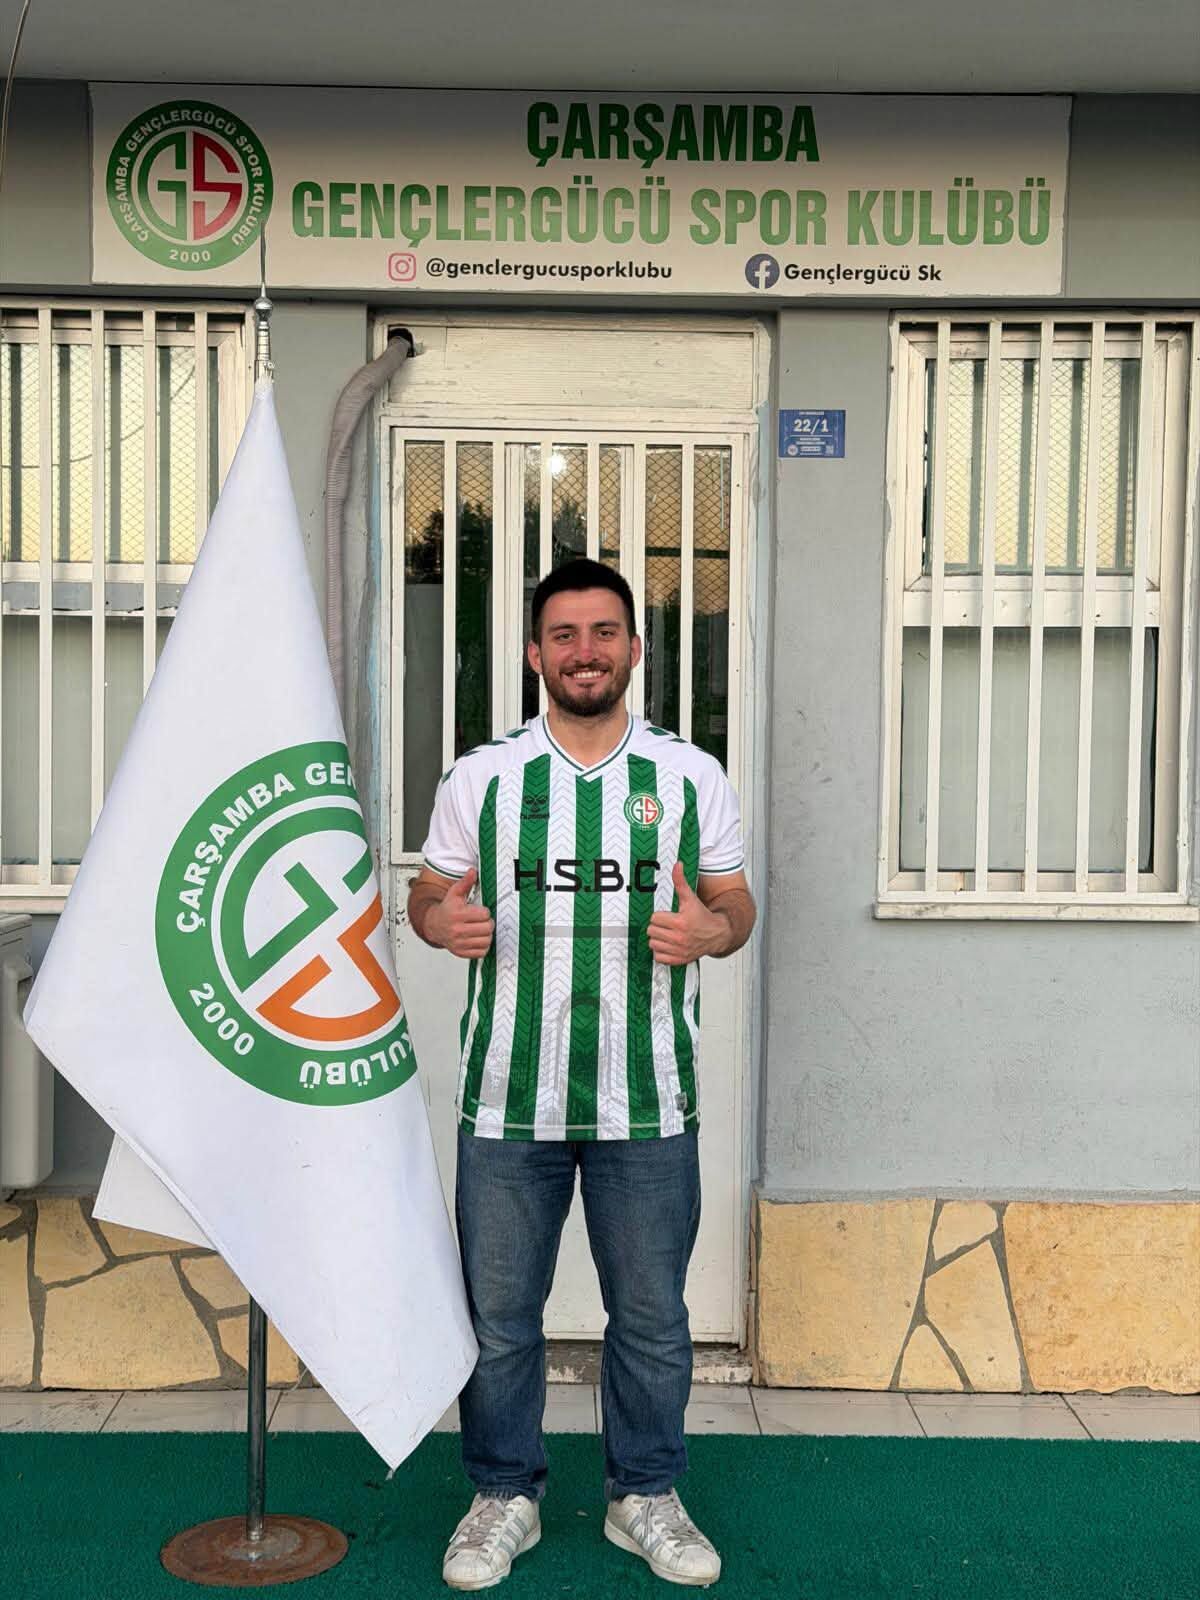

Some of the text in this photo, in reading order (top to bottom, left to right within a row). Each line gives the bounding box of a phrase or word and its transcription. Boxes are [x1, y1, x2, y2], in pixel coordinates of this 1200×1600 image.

[125, 109, 237, 153] GENÇLERGÜCÜ
[527, 102, 820, 169] ÇARŞAMBA
[236, 135, 263, 179] SPOR
[231, 183, 265, 246] KULÜBÜ
[292, 175, 1051, 248] GENÇLERGÜCÜ SPOR KULÜBÜ
[169, 249, 211, 263] 2000
[425, 257, 673, 281] @genclergucusporklubu
[784, 263, 911, 284] Gençlergücü
[918, 264, 942, 281] Sk
[793, 418, 829, 435] 22/1
[176, 772, 297, 933] ÇARŞAMBA
[513, 859, 661, 893] H.S.B.C
[189, 982, 256, 1056] 2000
